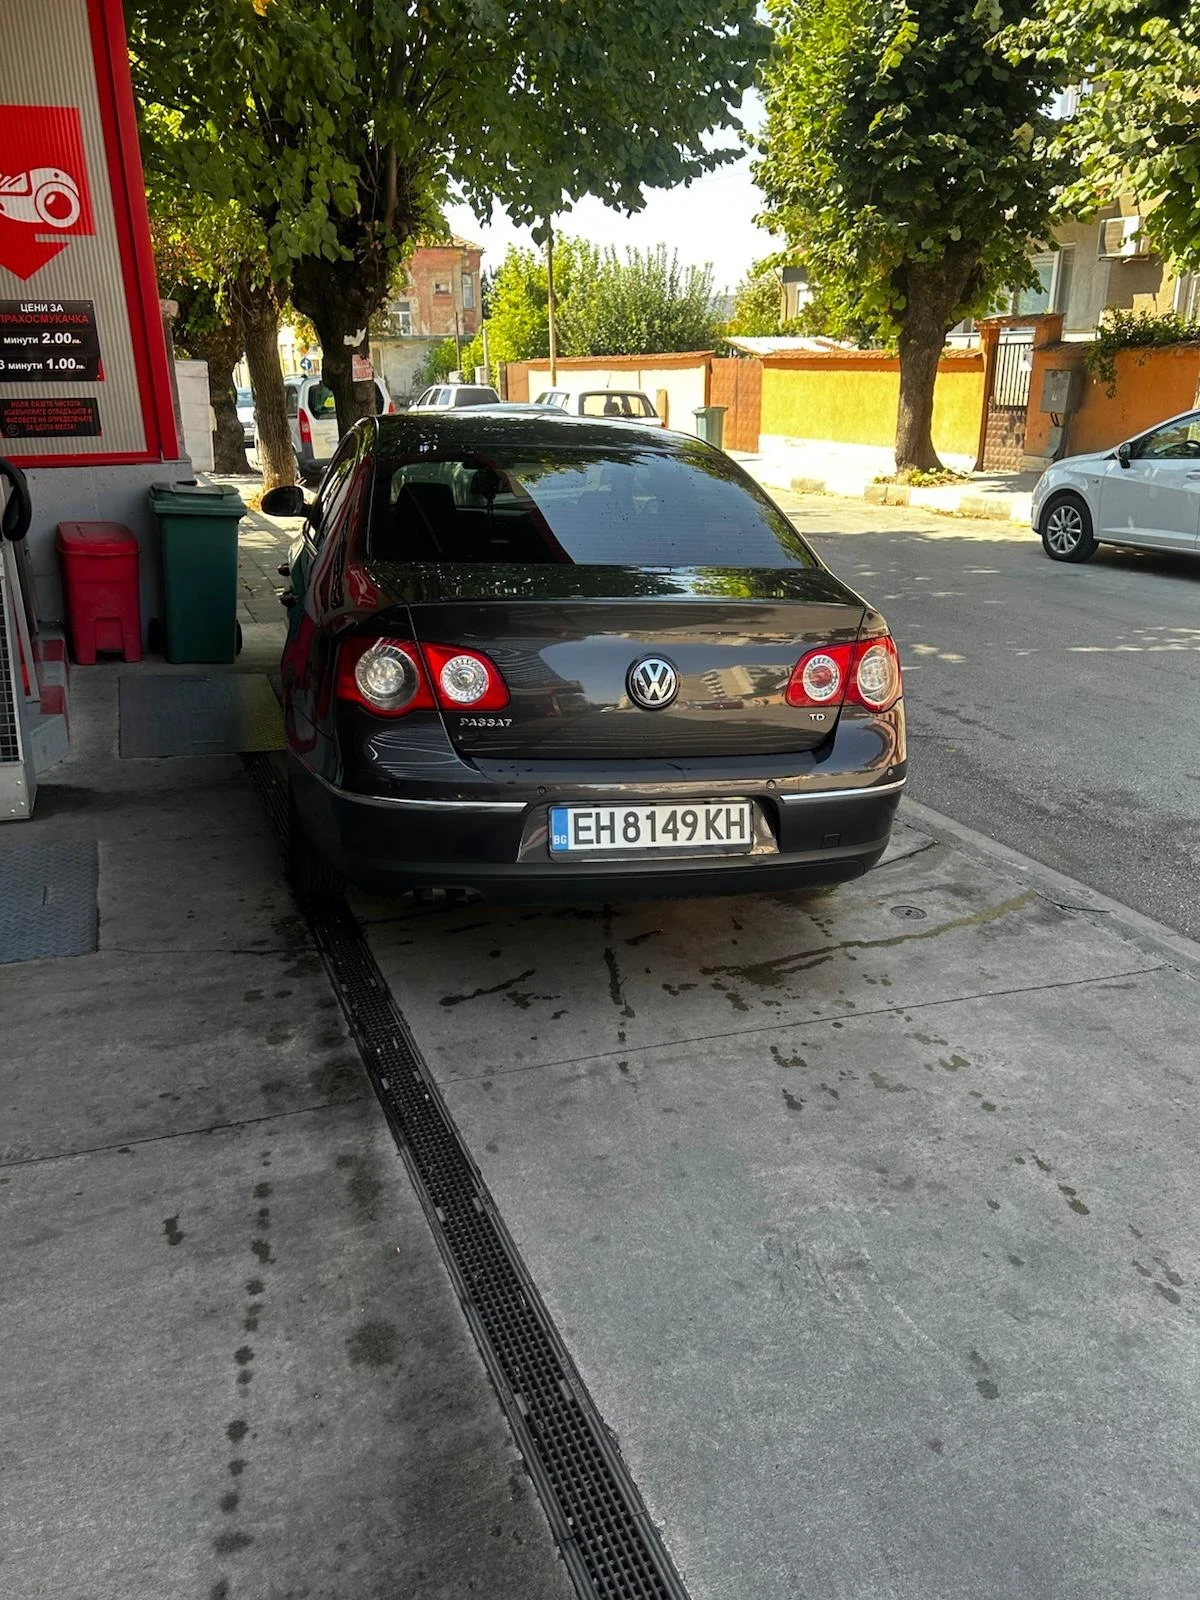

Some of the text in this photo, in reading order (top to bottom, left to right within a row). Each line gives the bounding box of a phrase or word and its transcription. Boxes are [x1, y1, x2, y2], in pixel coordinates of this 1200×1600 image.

[20, 303, 64, 313] ЦЕНИ ЗА
[4, 337, 39, 345] минути
[8, 363, 43, 371] минути
[460, 717, 513, 727] PASSAT
[553, 834, 567, 845] BG
